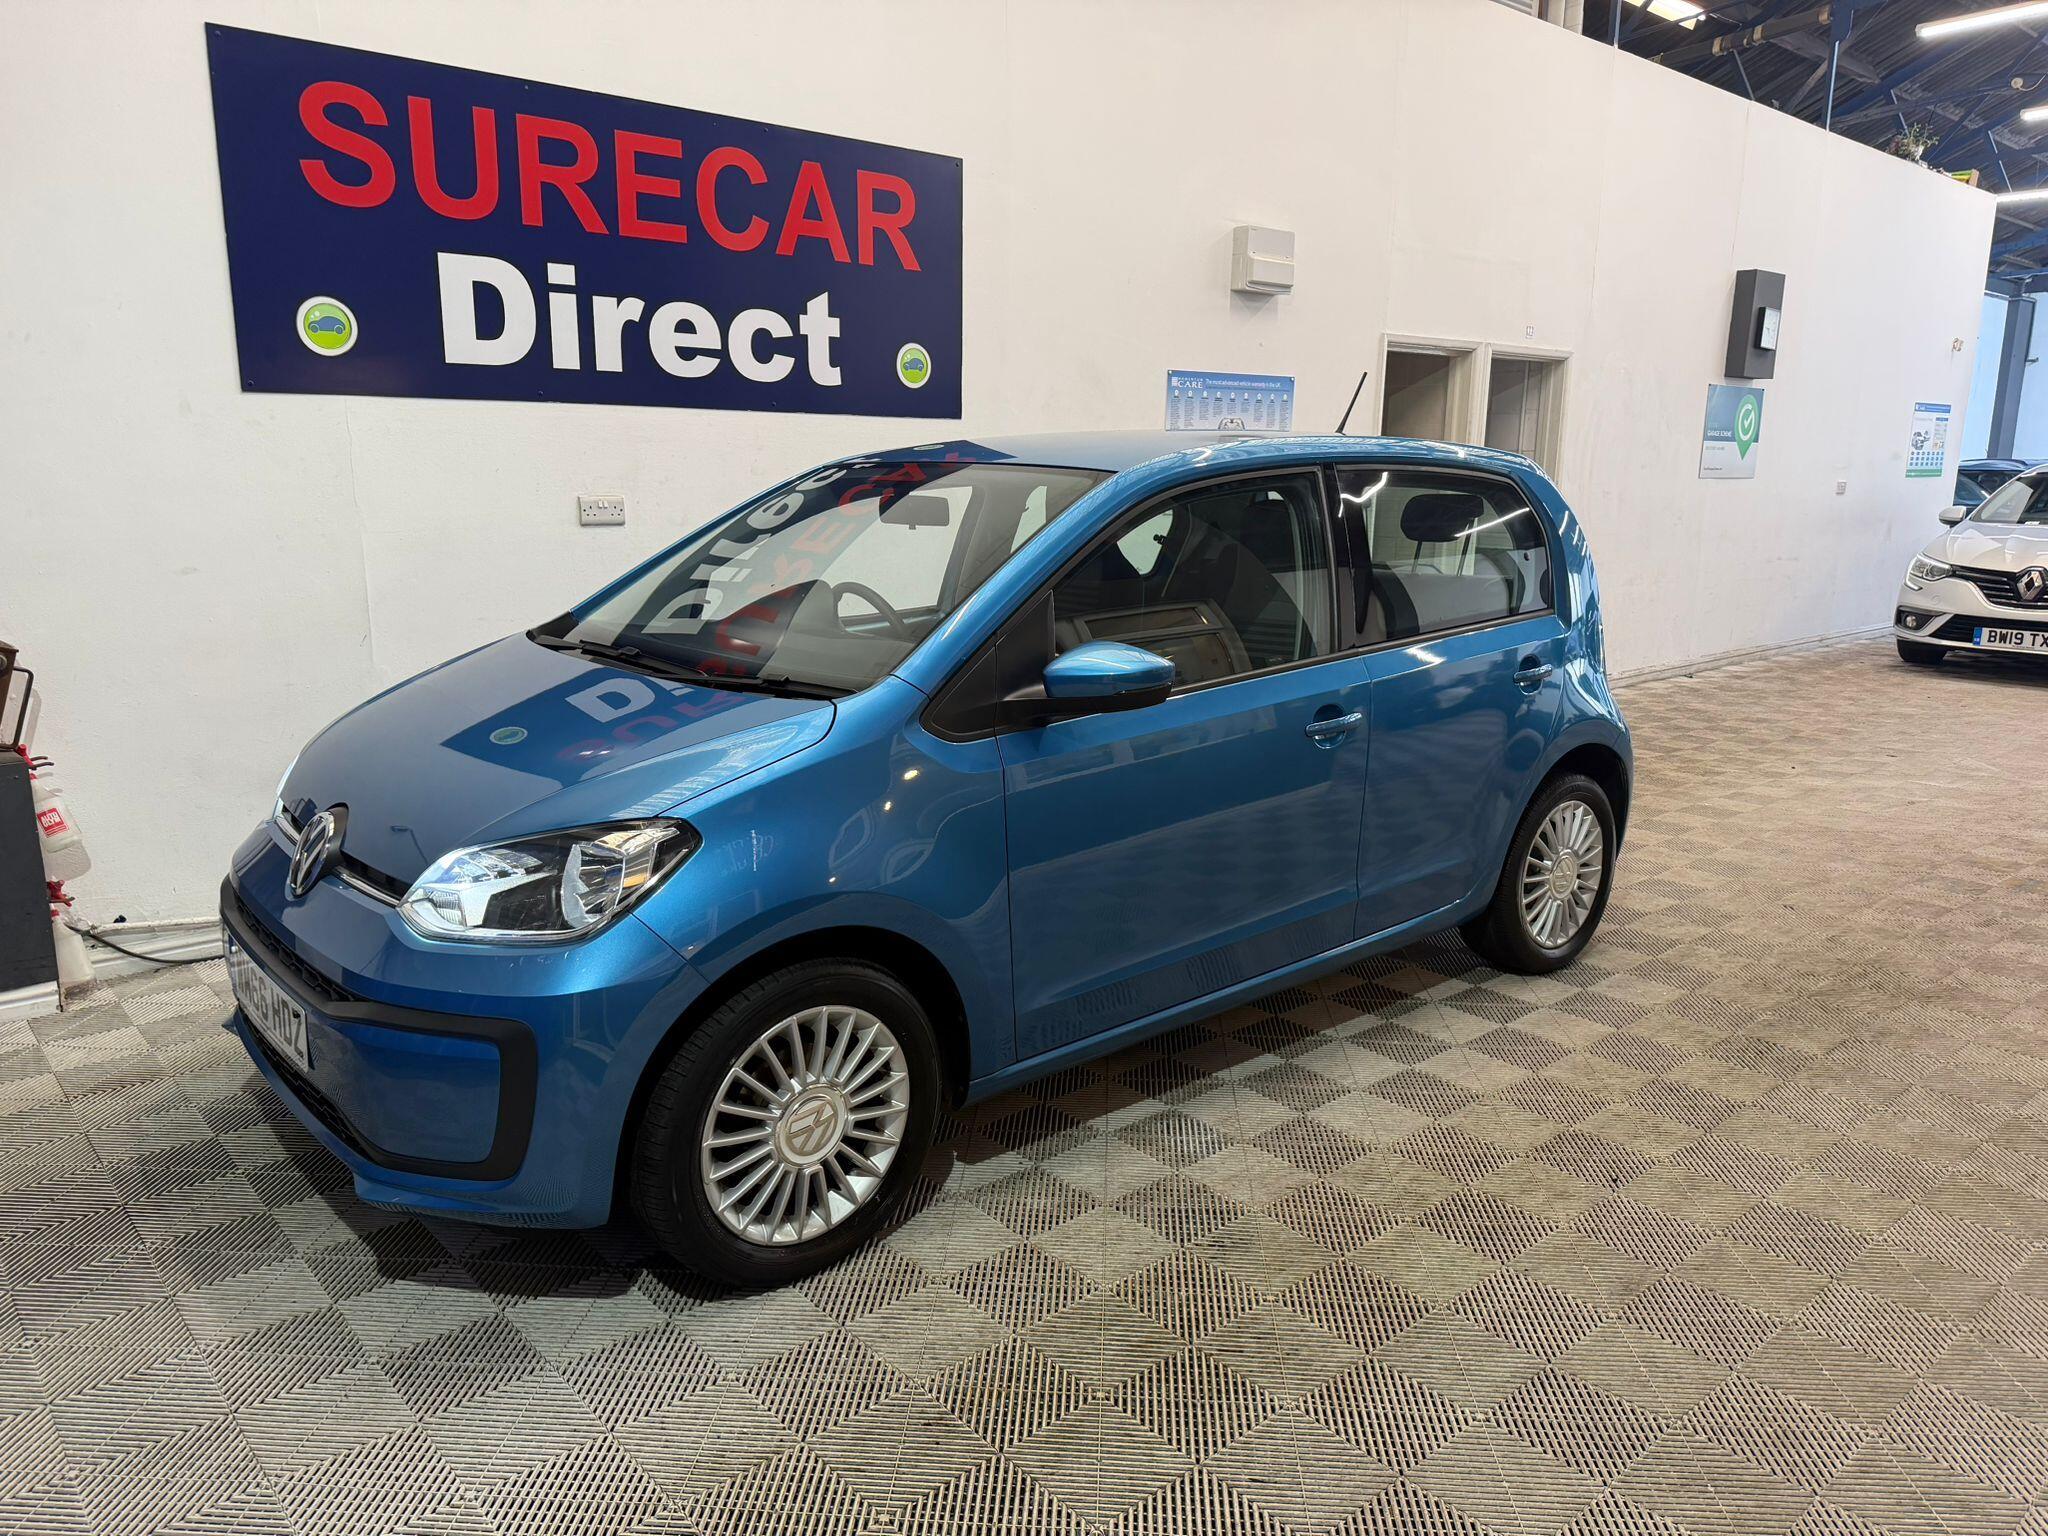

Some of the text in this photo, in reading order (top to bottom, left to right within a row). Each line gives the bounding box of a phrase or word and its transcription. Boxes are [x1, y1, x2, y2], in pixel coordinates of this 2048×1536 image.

[298, 80, 921, 271] SURECAR
[437, 251, 841, 387] Direct
[1178, 380, 1203, 389] CARE
[1987, 630, 2025, 646] BW19
